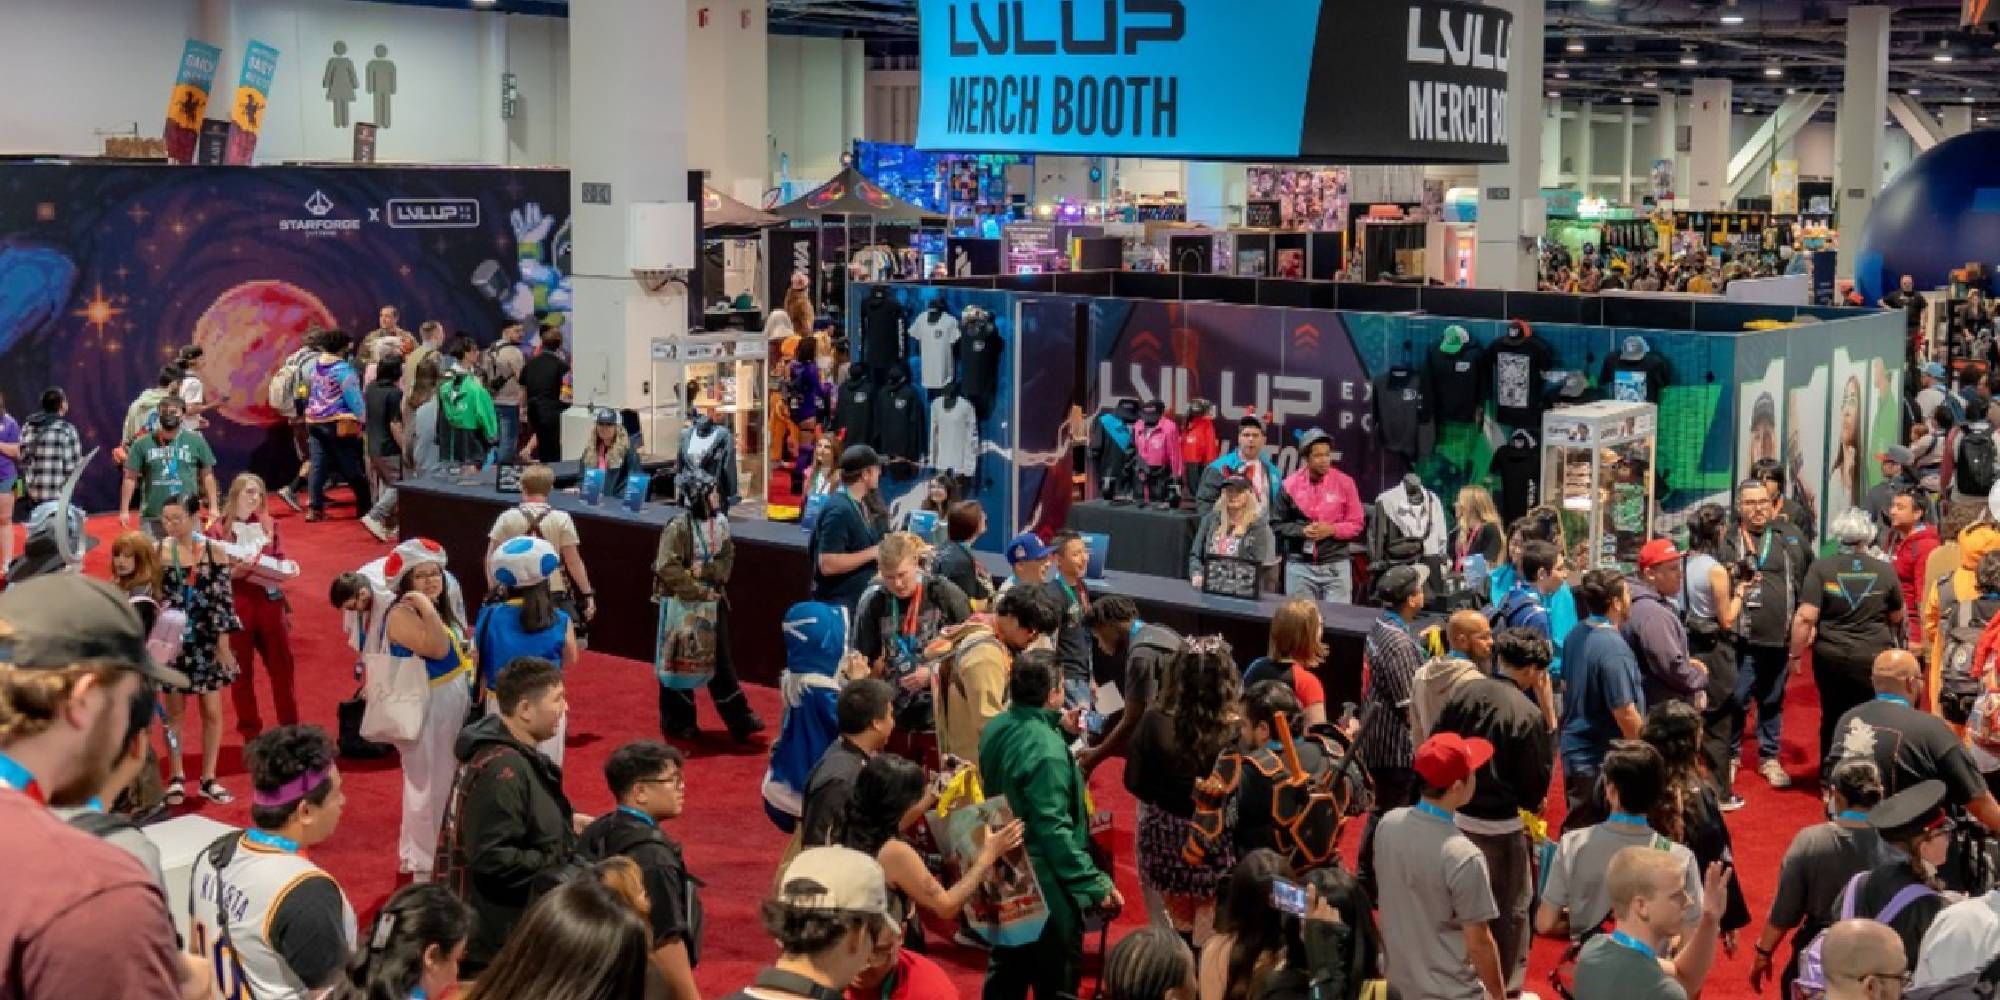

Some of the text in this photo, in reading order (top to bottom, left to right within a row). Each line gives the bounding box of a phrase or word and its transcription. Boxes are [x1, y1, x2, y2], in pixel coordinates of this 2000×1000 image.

[948, 0, 1187, 56] LVLUP
[947, 74, 1179, 138] MERCH BOOTH
[1408, 80, 1488, 144] MERCH
[279, 219, 361, 230] STARFORGE
[396, 205, 457, 221] LVLUP
[1100, 360, 1324, 425] LVLUP
